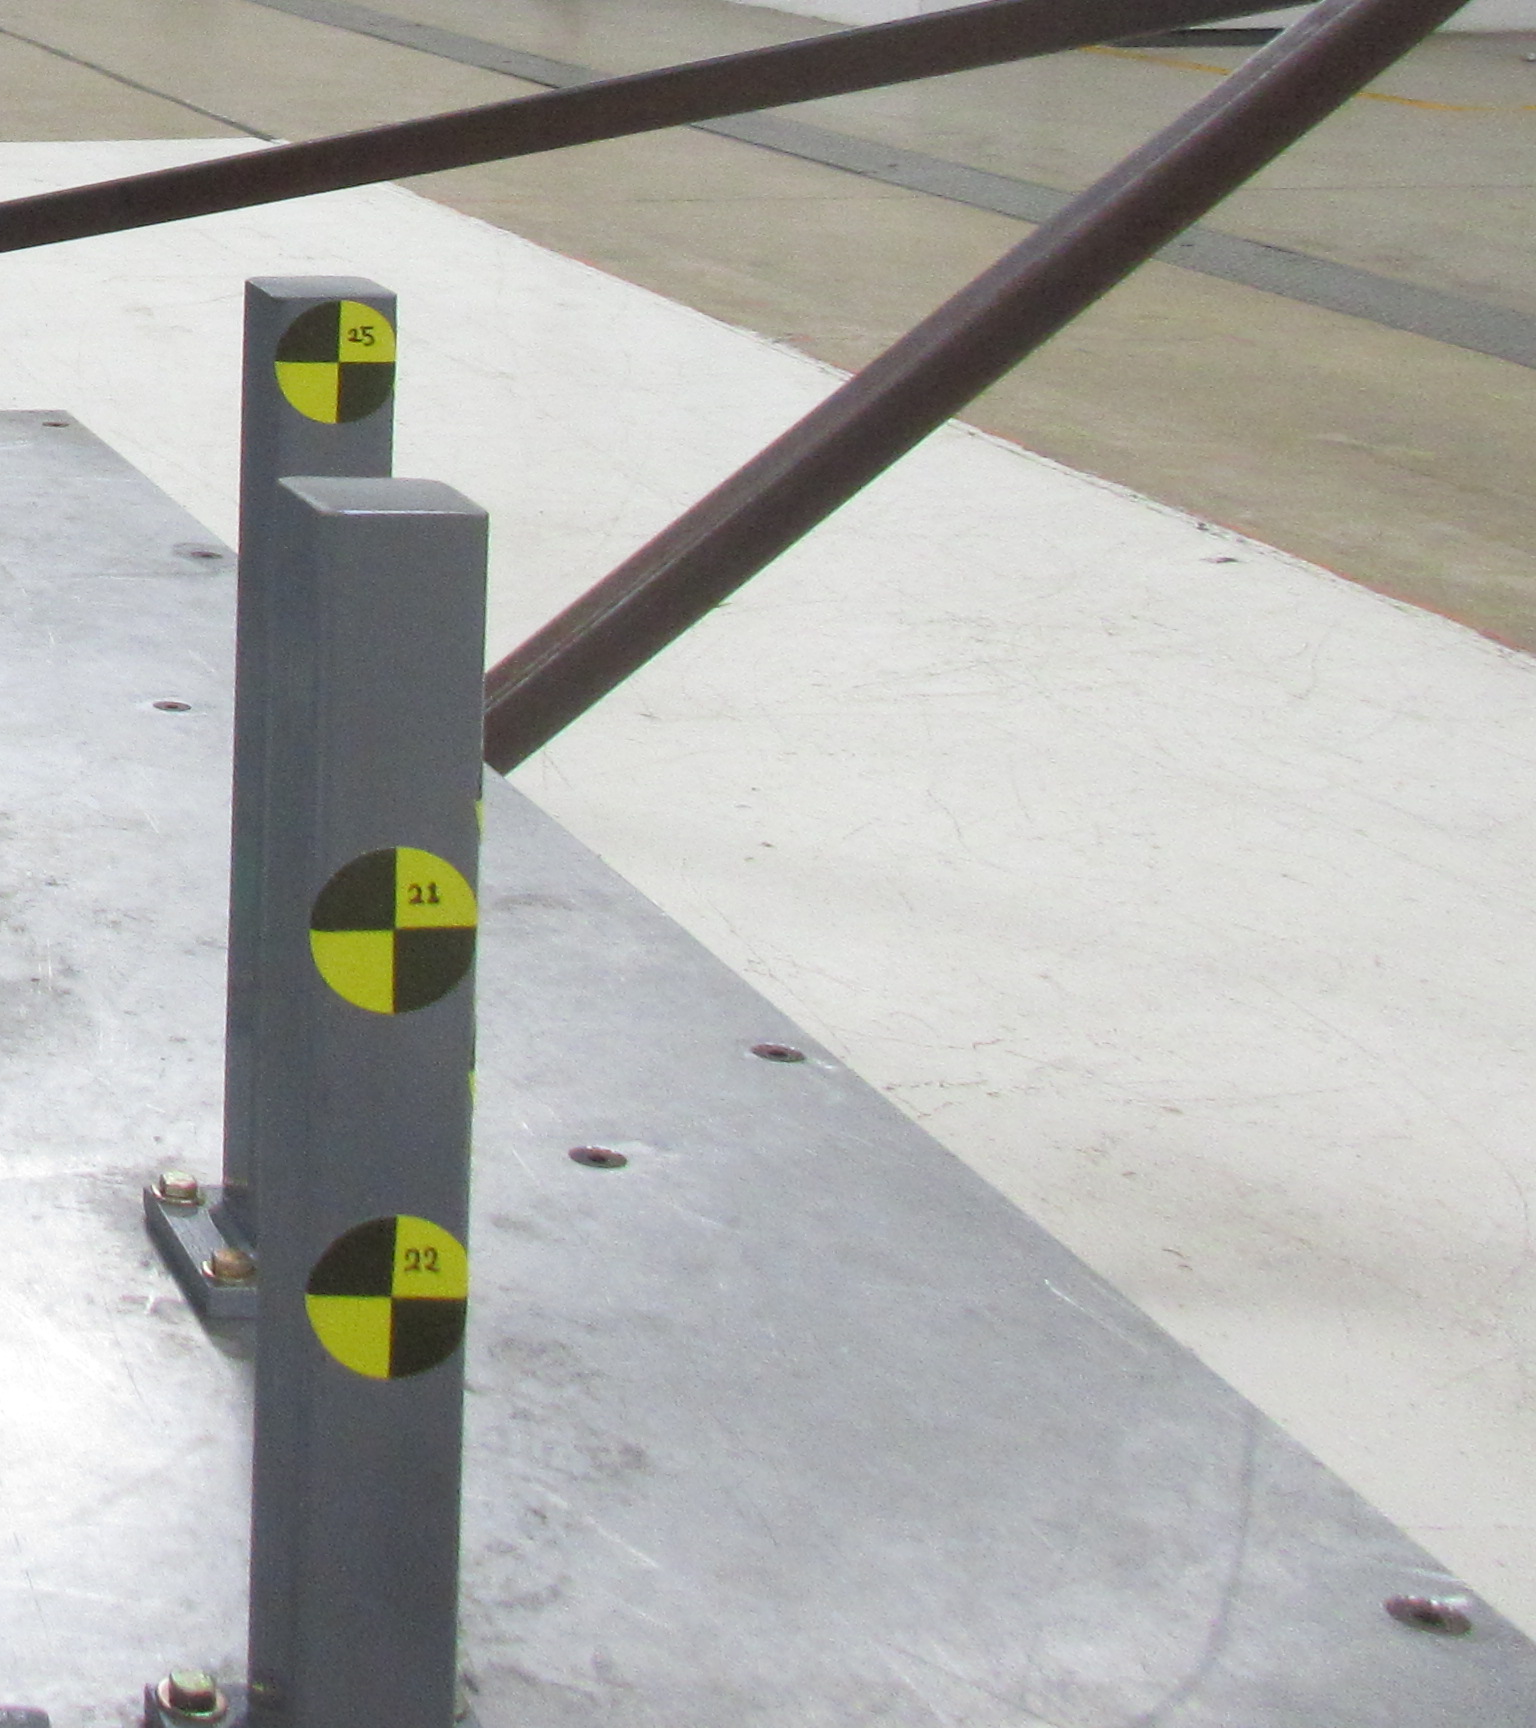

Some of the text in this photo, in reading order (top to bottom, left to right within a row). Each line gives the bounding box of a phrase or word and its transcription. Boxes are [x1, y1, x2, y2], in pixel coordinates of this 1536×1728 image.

[347, 325, 376, 347] 25
[407, 881, 441, 905] 21
[403, 1246, 441, 1273] 22
